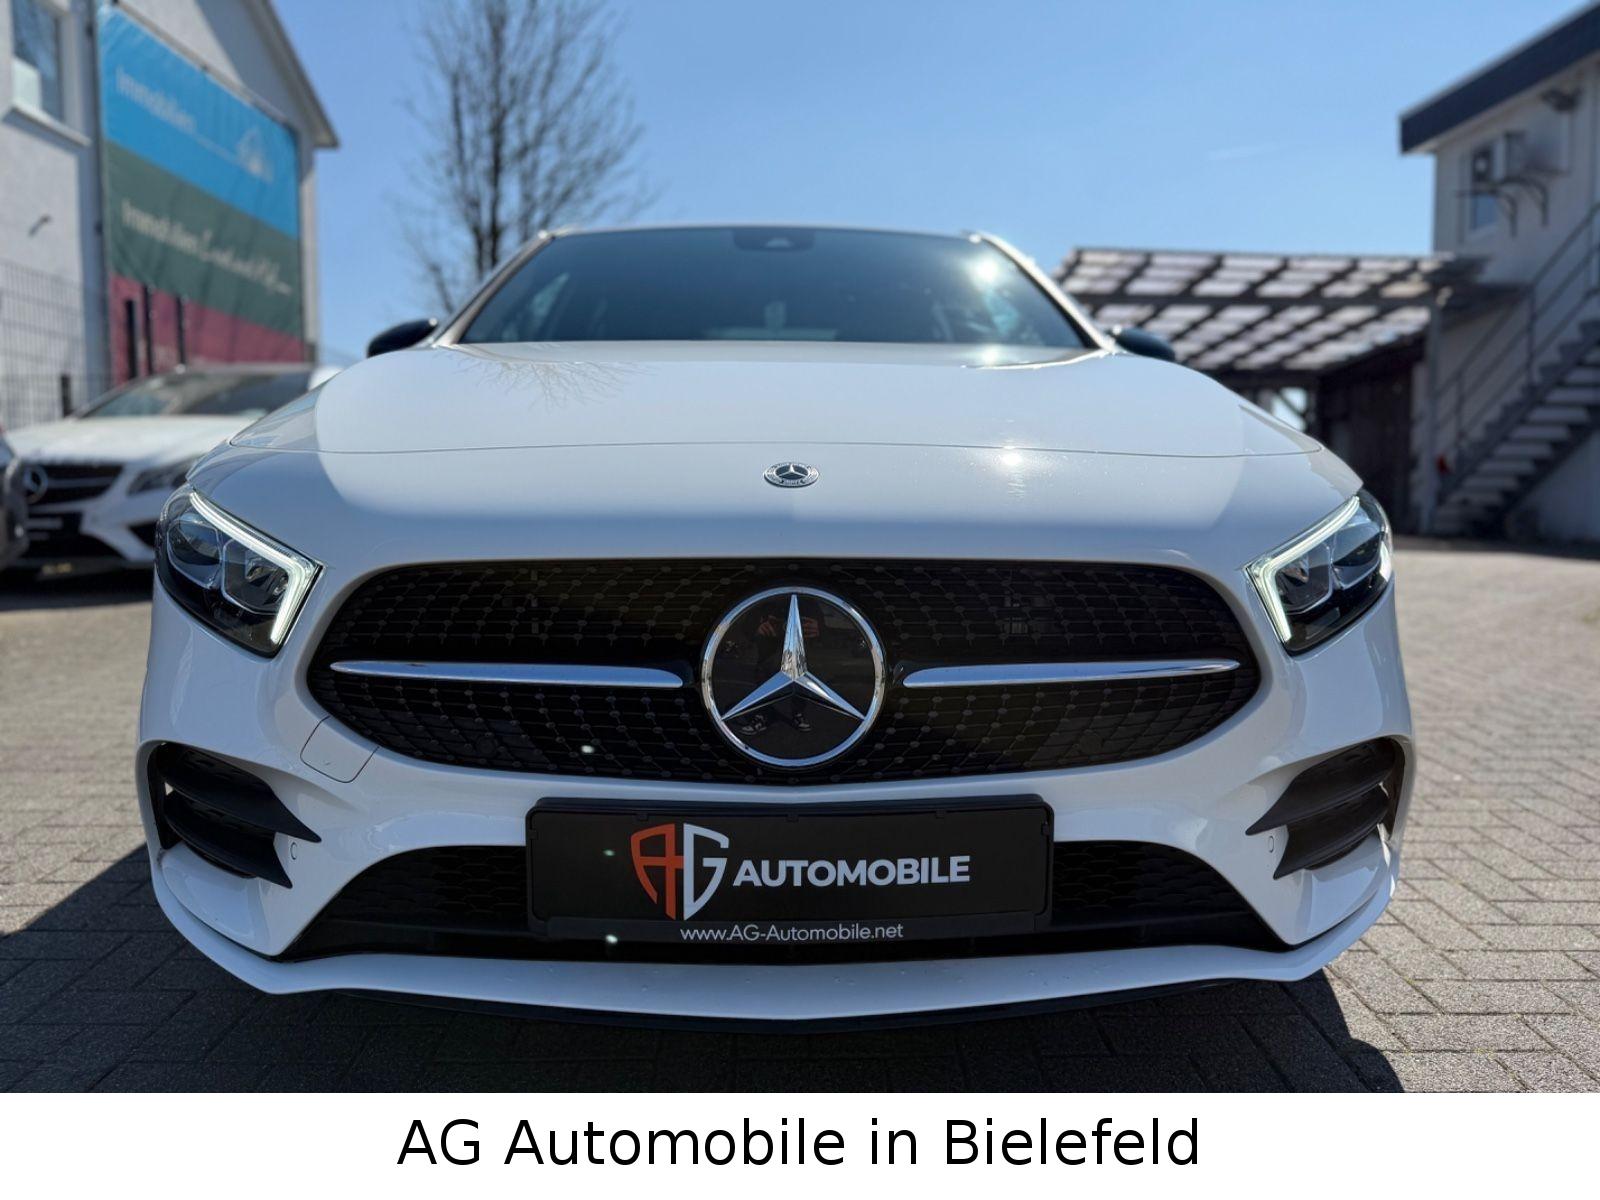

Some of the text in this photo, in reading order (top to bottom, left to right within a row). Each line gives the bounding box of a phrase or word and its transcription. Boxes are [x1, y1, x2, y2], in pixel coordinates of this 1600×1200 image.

[630, 823, 971, 921] AG AUTOMOBILE
[679, 922, 904, 942] www.AG-Automobile.net
